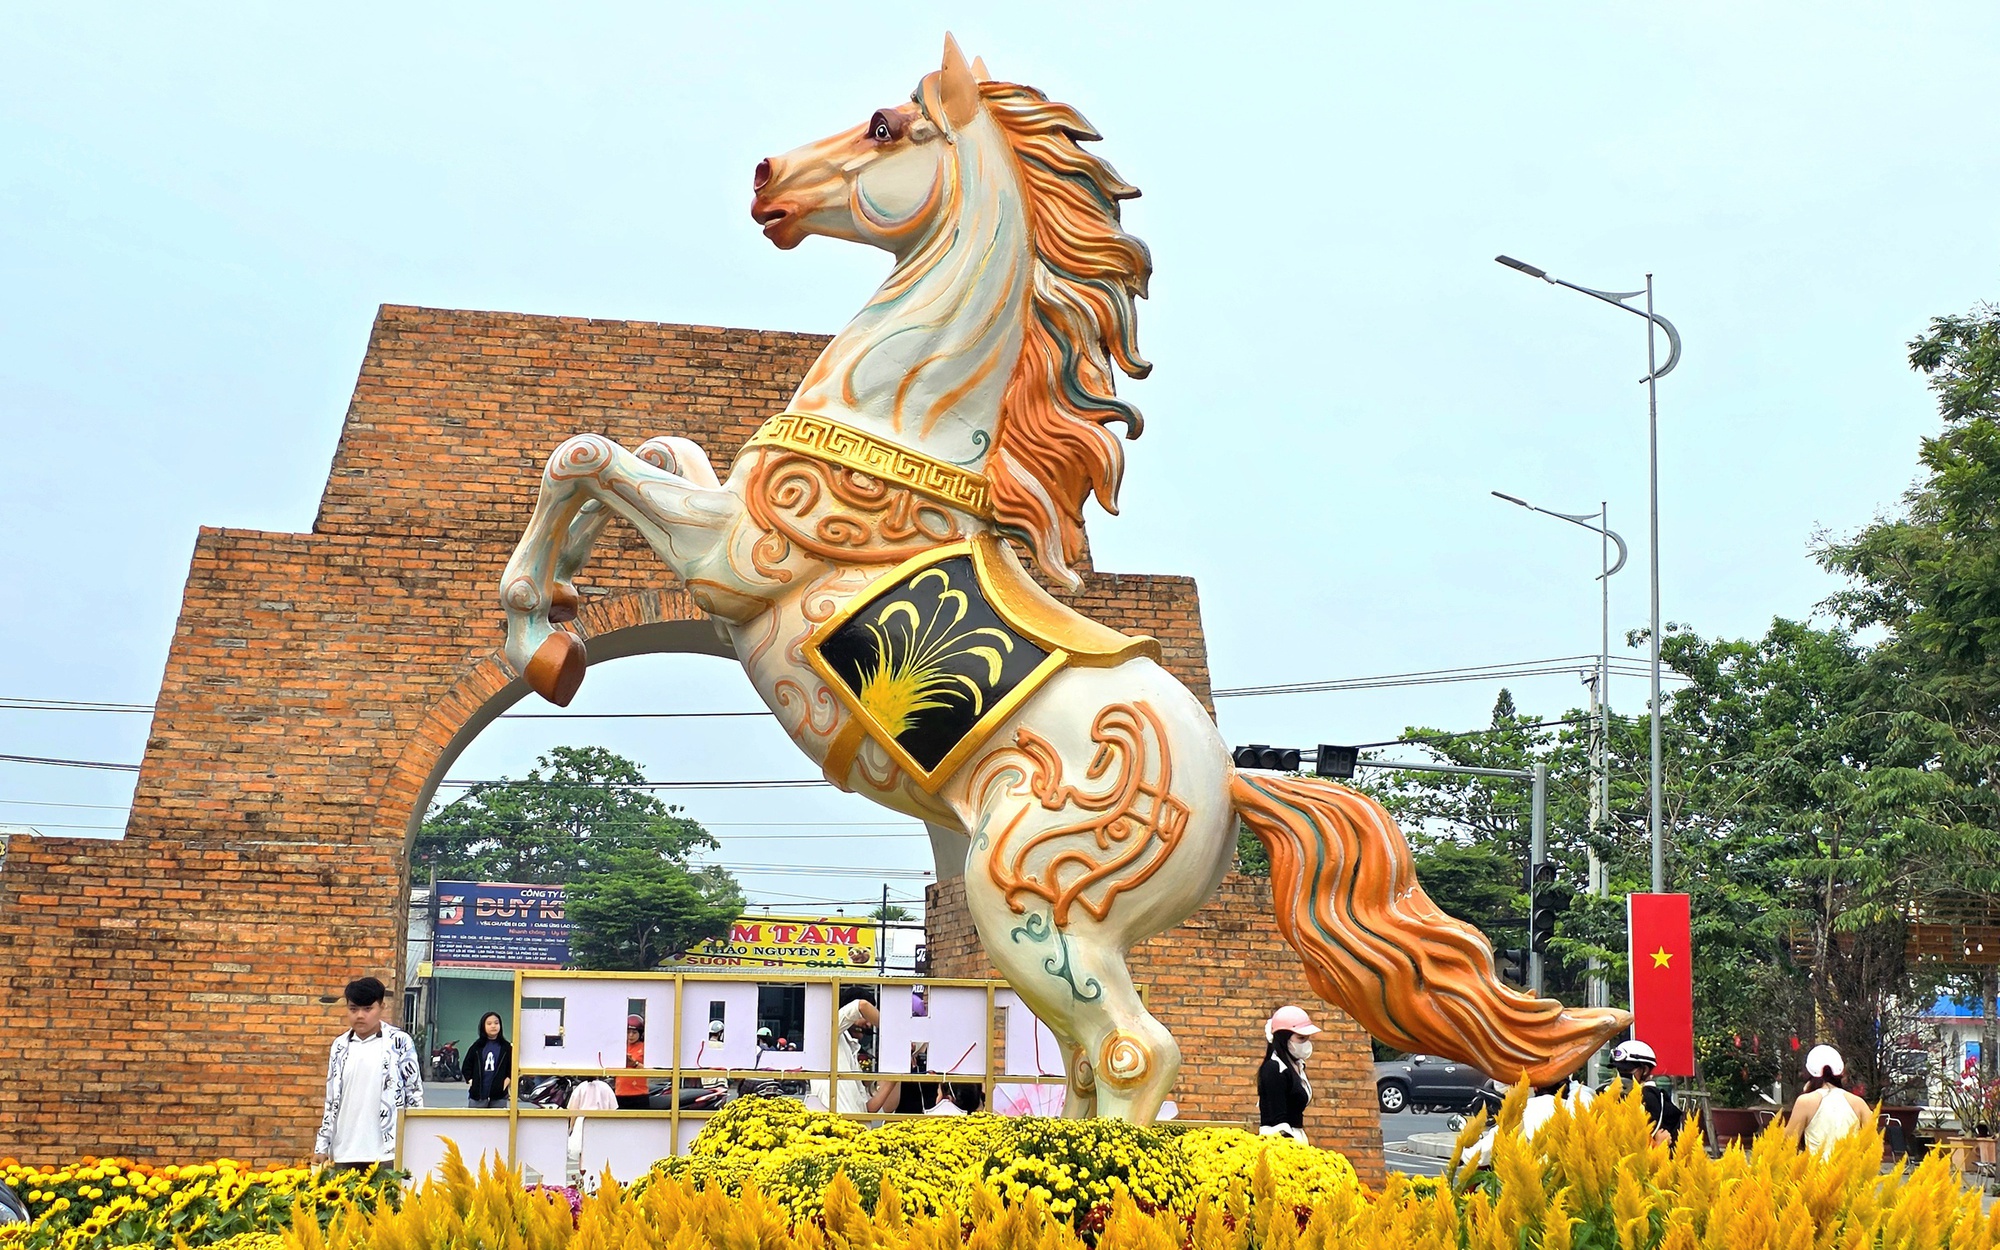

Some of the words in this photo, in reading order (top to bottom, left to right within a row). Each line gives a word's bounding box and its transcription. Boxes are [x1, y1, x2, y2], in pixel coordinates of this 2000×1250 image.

[520, 888, 546, 898] CÔNG
[476, 897, 536, 918] DUY
[753, 945, 820, 957] NGUYÊN
[826, 948, 836, 957] 2
